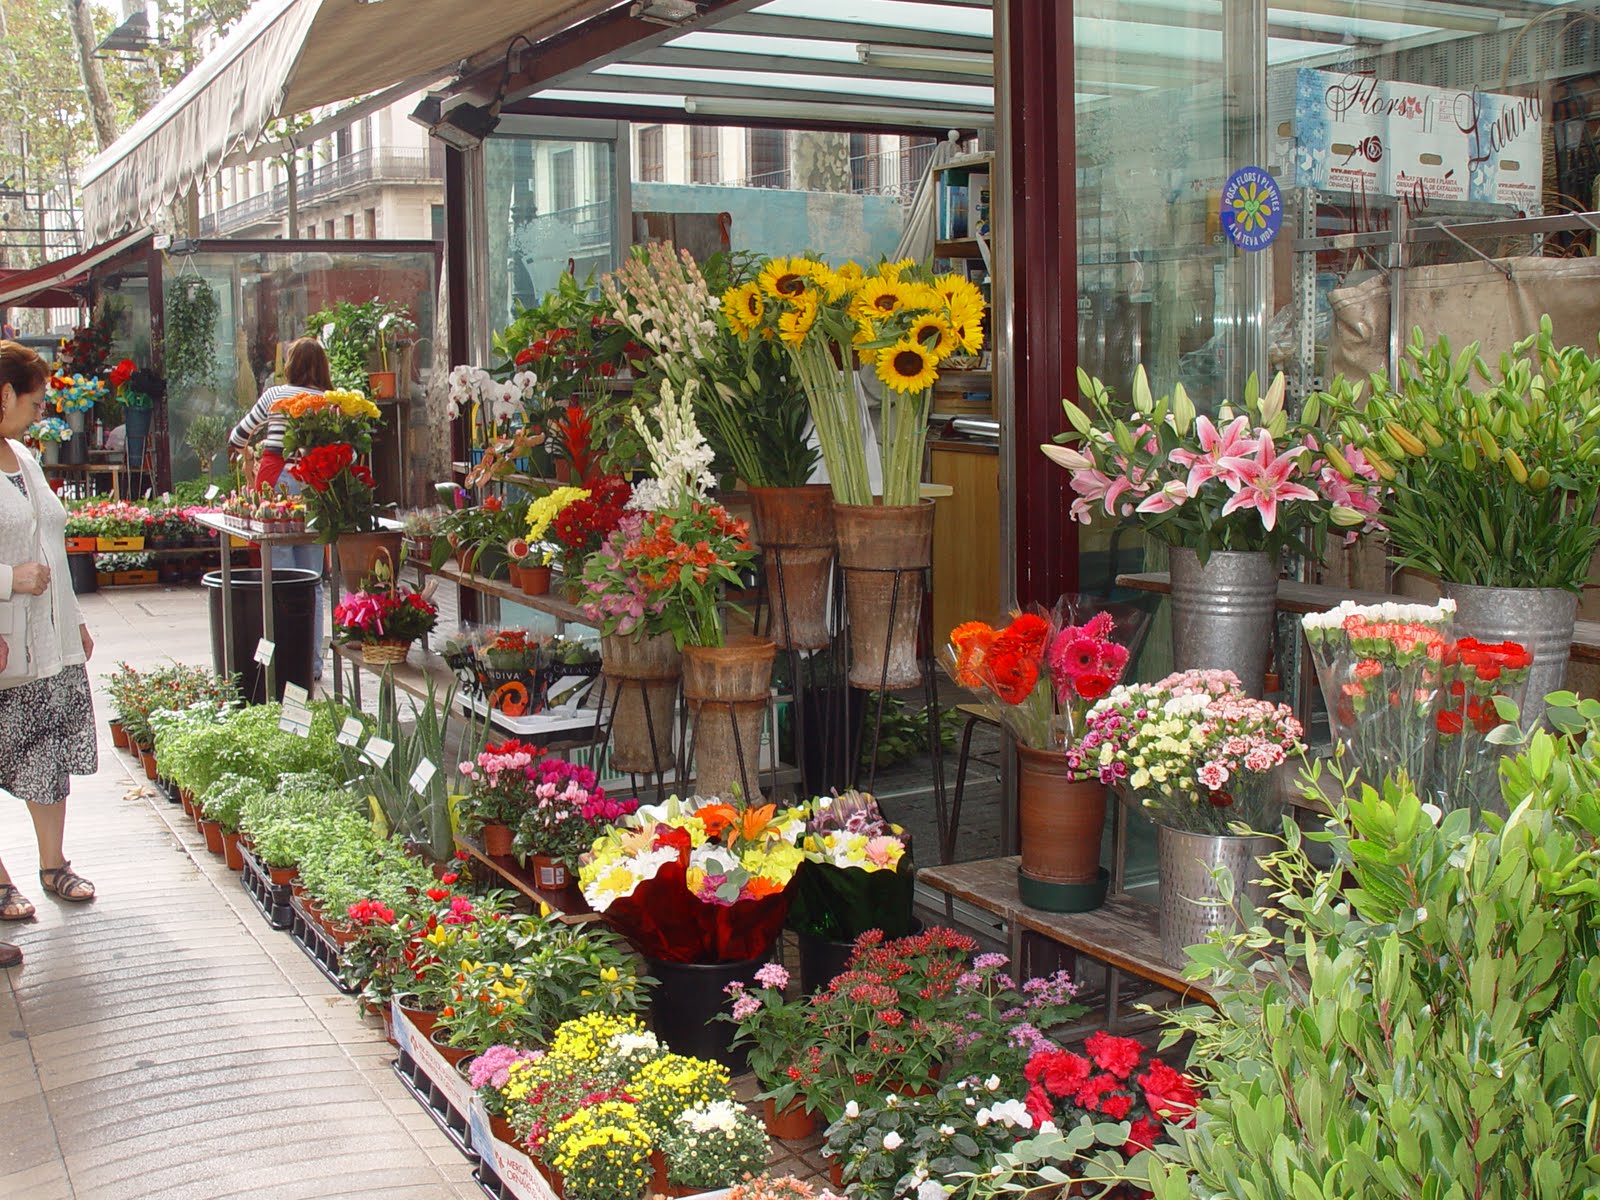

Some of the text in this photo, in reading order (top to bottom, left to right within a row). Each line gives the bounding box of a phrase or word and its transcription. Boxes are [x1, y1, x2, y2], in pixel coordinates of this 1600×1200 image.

[1225, 183, 1239, 205] POSA
[1236, 172, 1257, 186] FLORS
[1257, 174, 1261, 184] I
[1261, 177, 1280, 212] PLANTES
[1436, 184, 1464, 193] CATALUNYA
[1228, 223, 1275, 246] A LA TEVA VIDA
